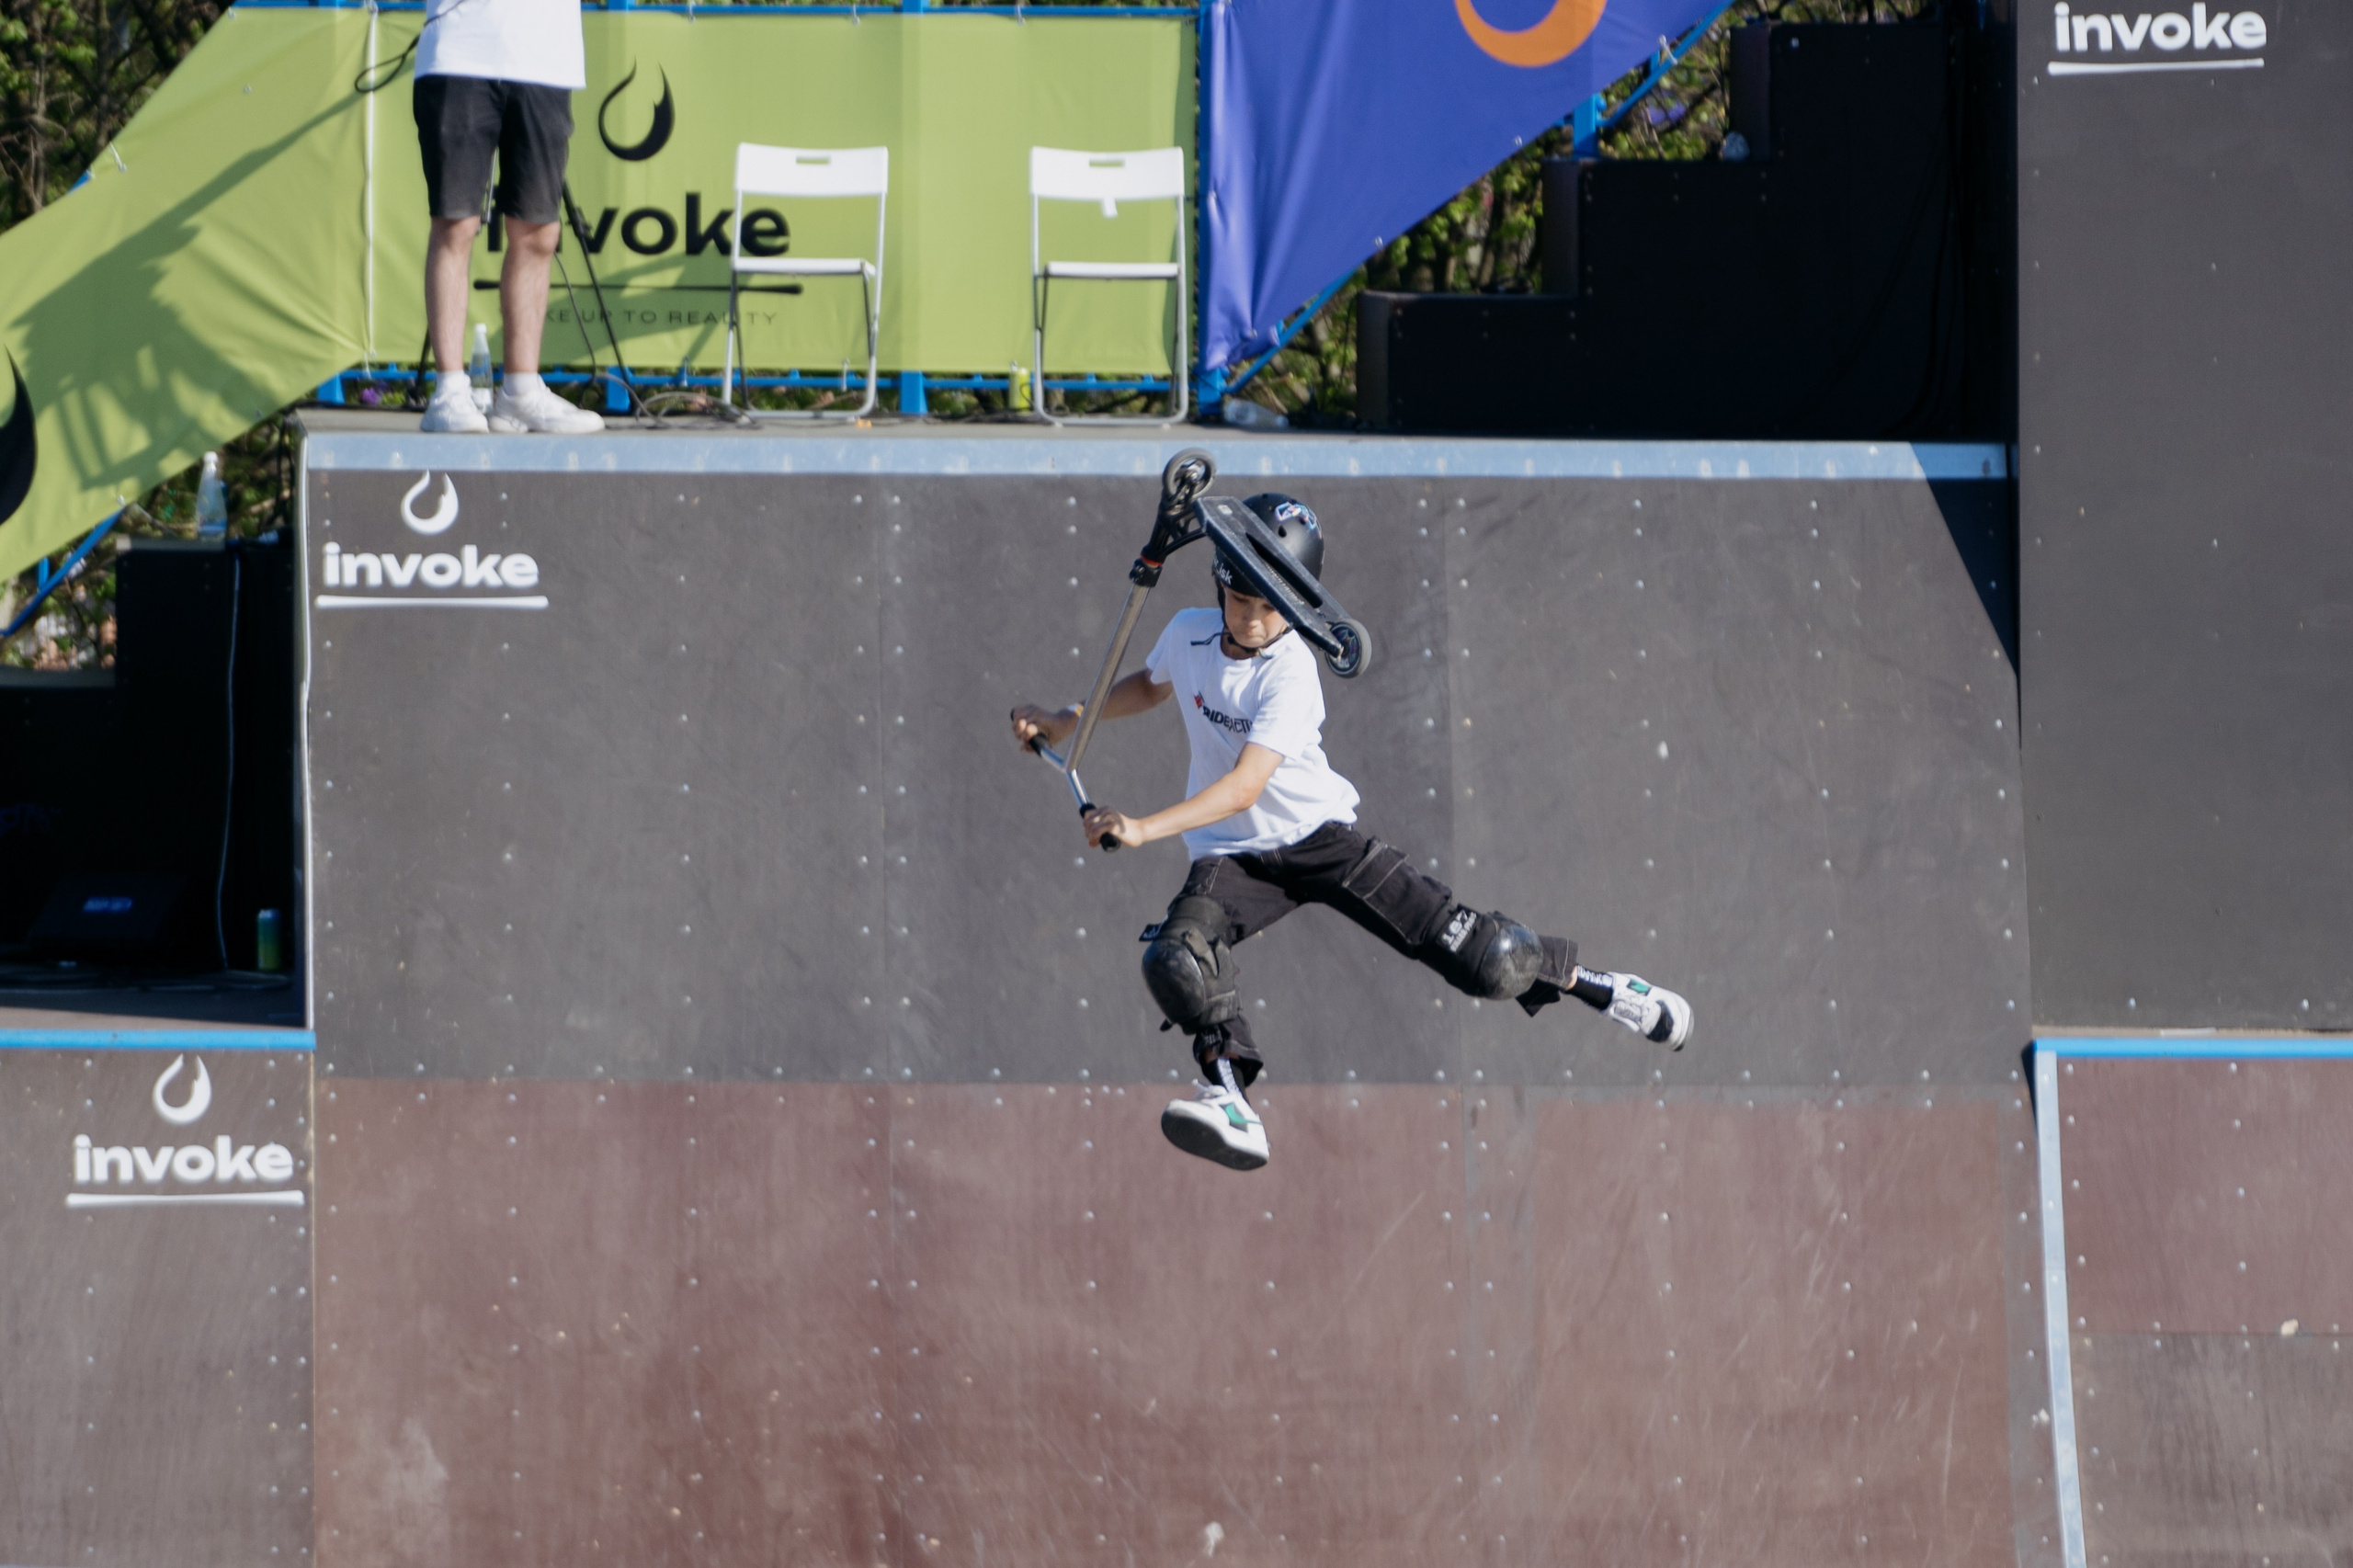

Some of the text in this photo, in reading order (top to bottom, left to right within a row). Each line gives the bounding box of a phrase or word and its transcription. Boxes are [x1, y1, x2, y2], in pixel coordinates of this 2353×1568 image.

[2054, 1, 2268, 52] invoke
[486, 185, 790, 257] ivoke
[627, 311, 657, 323] TO
[669, 311, 778, 324] REALTY
[324, 541, 539, 588] invoke
[72, 1133, 294, 1183] invoke
